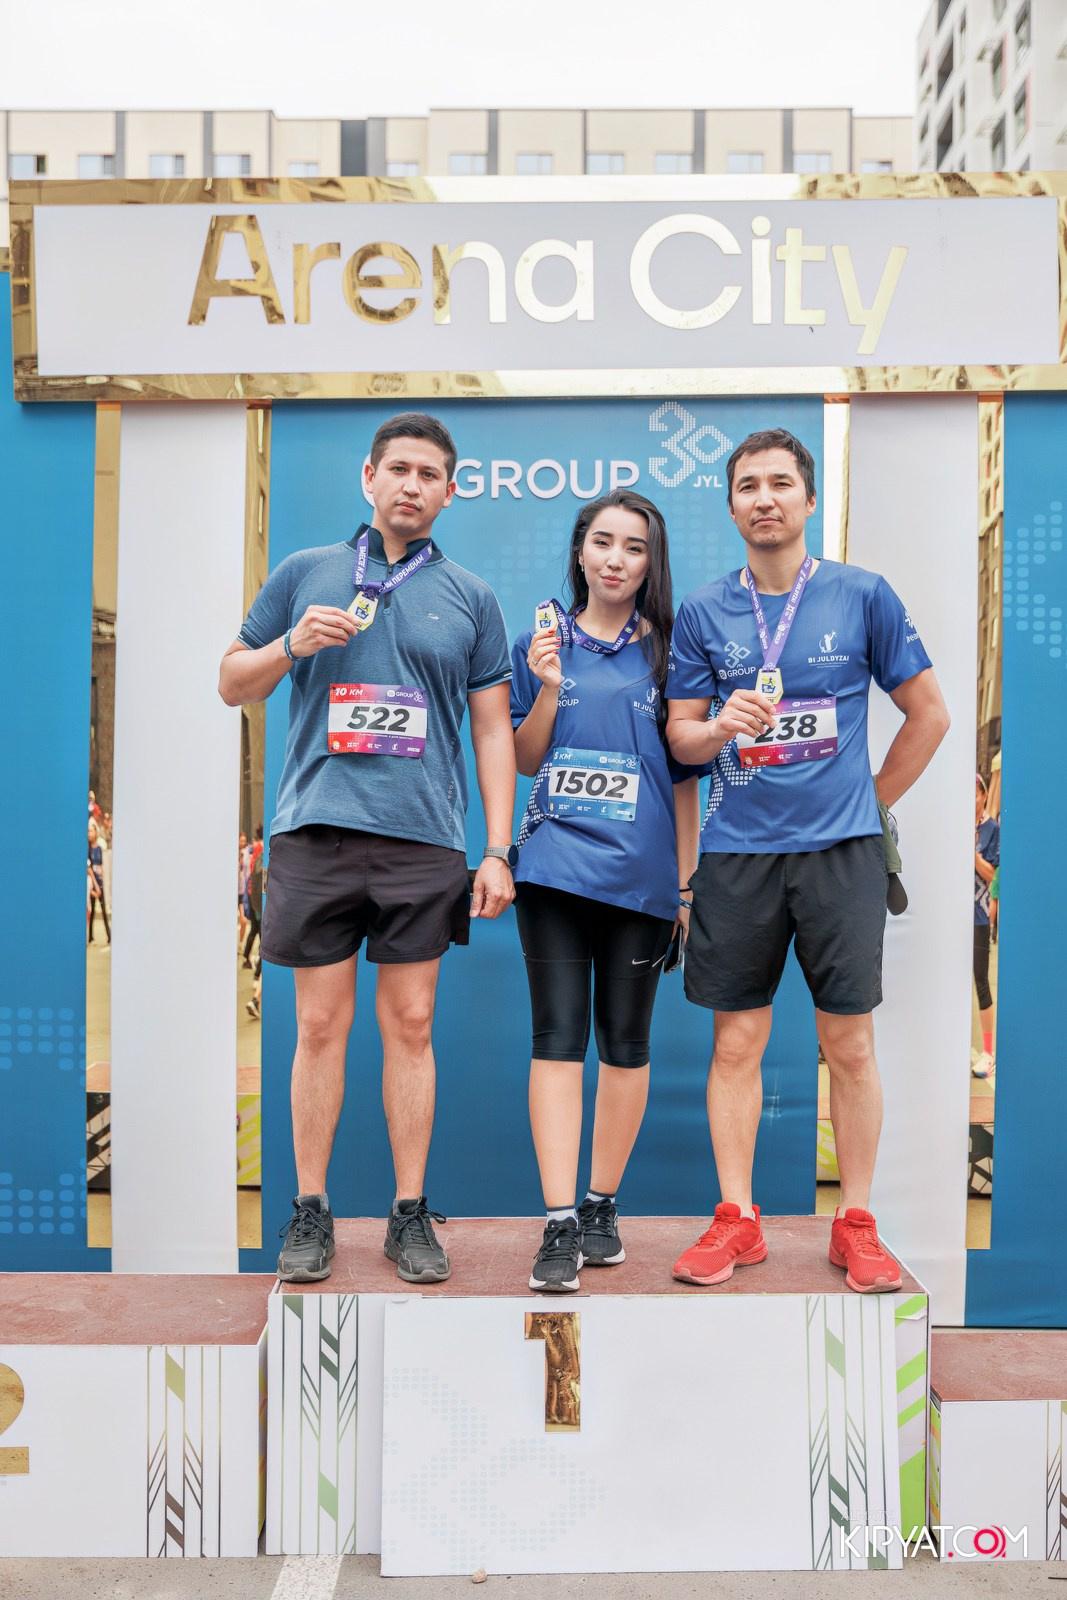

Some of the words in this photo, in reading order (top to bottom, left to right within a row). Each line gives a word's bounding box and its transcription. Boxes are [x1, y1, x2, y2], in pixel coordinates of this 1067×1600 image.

[187, 213, 595, 327] Arena
[628, 213, 909, 356] City
[453, 459, 640, 500] GROUP
[693, 474, 723, 488] JYL
[391, 553, 425, 587] ПЕРЕМЕНАМ
[817, 655, 849, 663] JULDYZAI
[727, 666, 756, 678] GROUP
[335, 688, 347, 696] 10
[557, 698, 580, 708] ROUP
[633, 700, 640, 708] BI
[347, 706, 410, 732] 522
[553, 751, 558, 760] 5
[555, 770, 629, 799] 1502
[524, 1312, 581, 1432] 1
